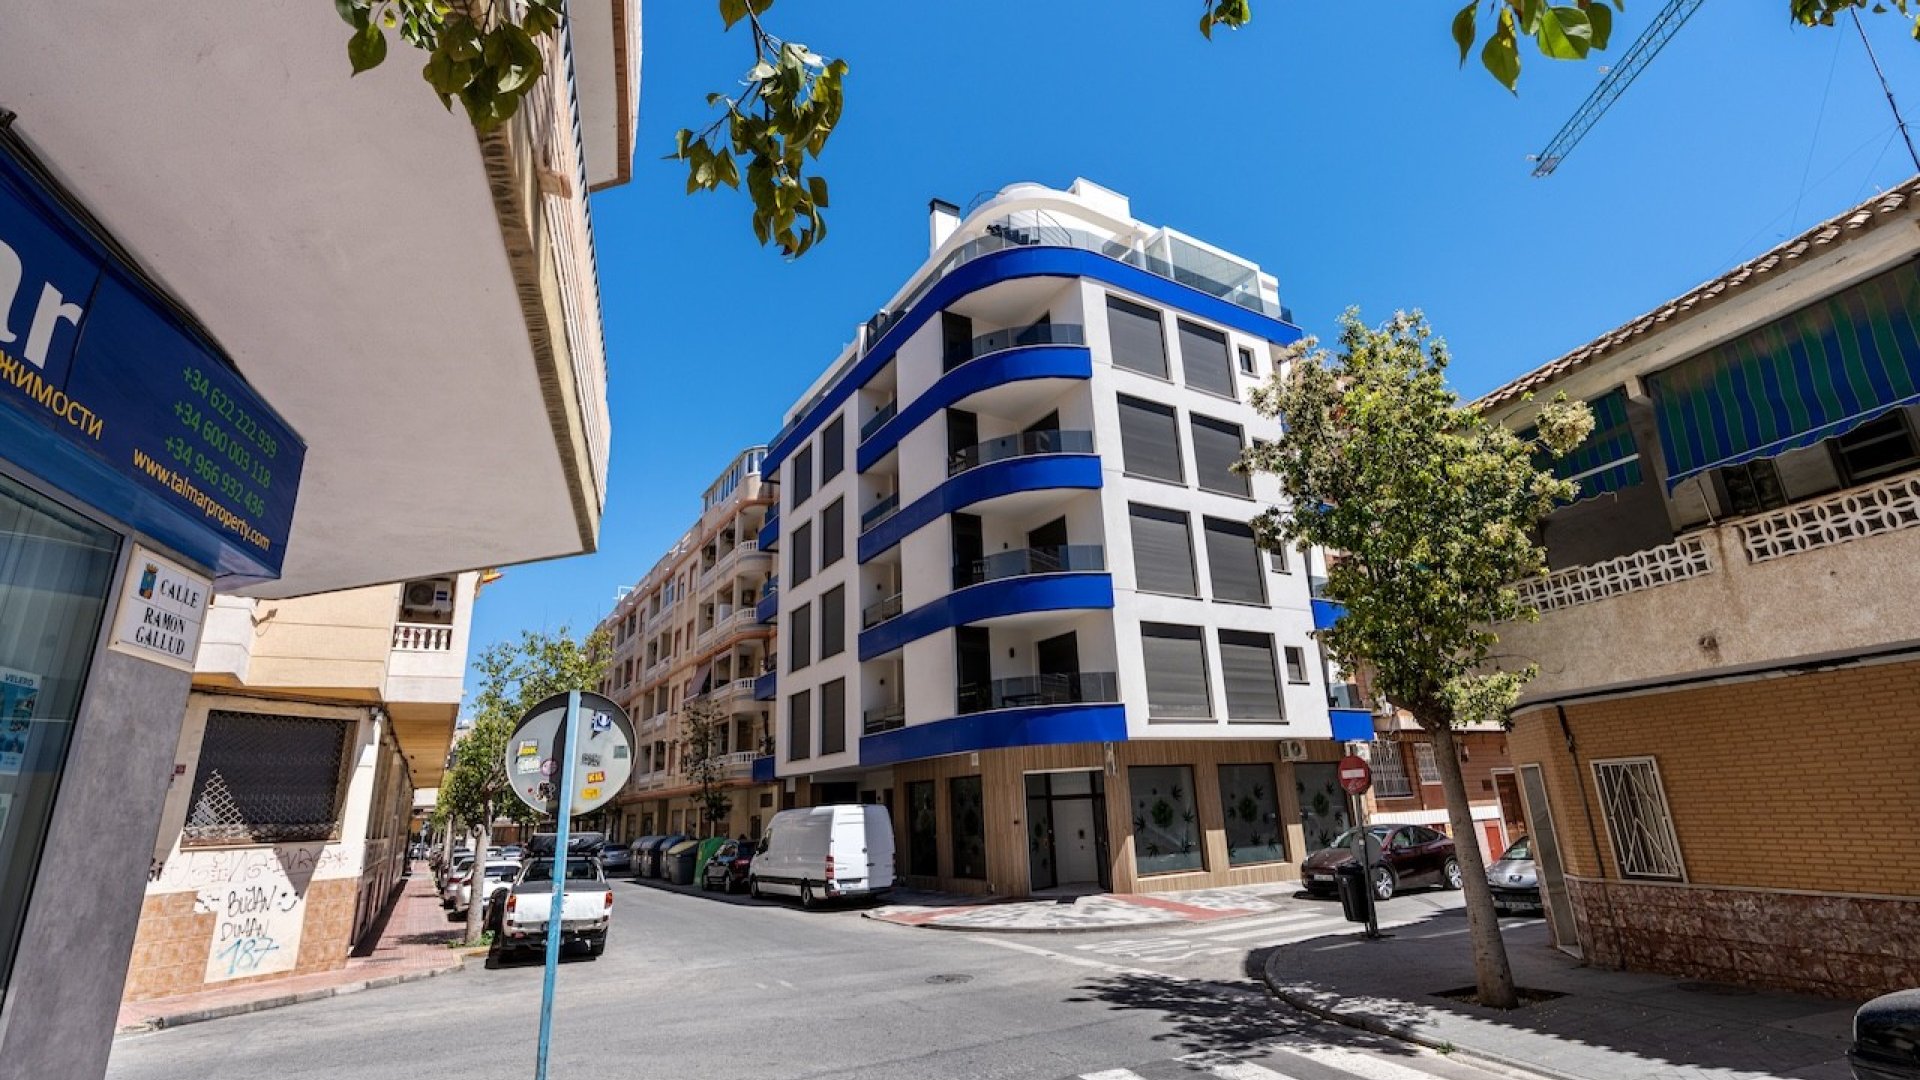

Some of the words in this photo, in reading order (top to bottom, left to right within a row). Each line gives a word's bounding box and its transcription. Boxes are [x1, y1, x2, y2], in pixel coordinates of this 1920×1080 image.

[183, 367, 209, 398] +34
[210, 388, 234, 421] 622
[235, 410, 257, 441] 222
[165, 436, 193, 467] +34
[195, 454, 220, 486] 966
[221, 473, 244, 503] 932
[174, 401, 201, 432] +34
[203, 420, 228, 452] 600
[227, 441, 250, 471] 003
[251, 461, 271, 489] 118
[134, 448, 271, 551] www.talmarproperty.com
[161, 579, 200, 609] CALLE
[135, 626, 186, 655] GALLUD
